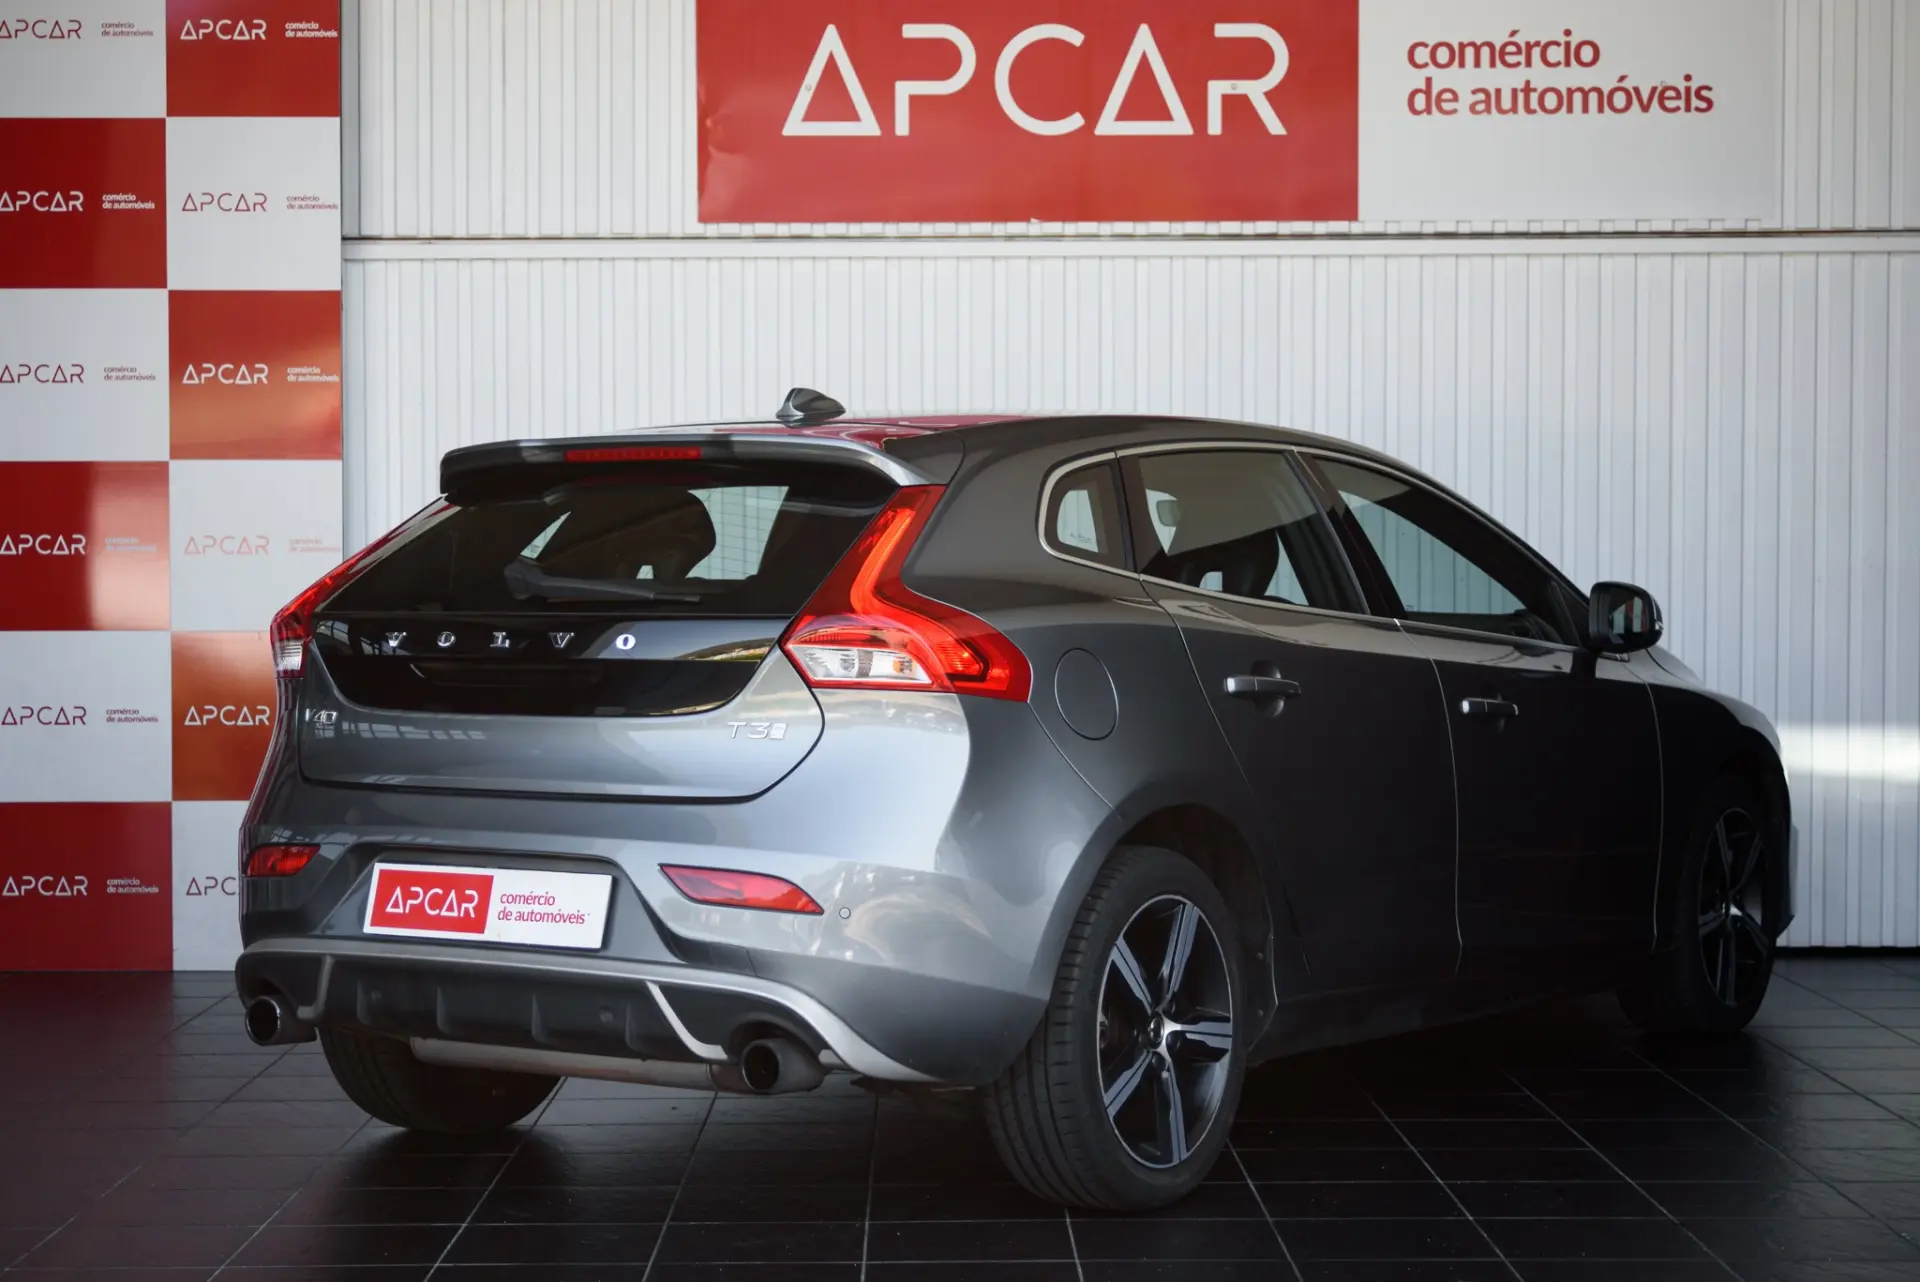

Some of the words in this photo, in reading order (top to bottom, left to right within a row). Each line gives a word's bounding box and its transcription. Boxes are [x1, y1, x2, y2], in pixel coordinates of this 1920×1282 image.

[0, 19, 82, 39] APCAR
[180, 19, 267, 40] APCAR
[285, 20, 319, 29] comércio
[285, 29, 295, 38] de
[296, 29, 338, 38] automóveis
[1407, 29, 1600, 69] comércio
[781, 23, 1290, 136] APCAR
[1407, 77, 1459, 116] de
[1469, 74, 1714, 116] automóveis
[0, 191, 84, 212] APCAR
[102, 193, 136, 201] comércio
[102, 201, 112, 209] de
[113, 200, 155, 209] automóveis
[182, 192, 267, 212] APCAR
[0, 363, 84, 384] APCAR
[182, 363, 269, 385] APCAR
[0, 534, 86, 555] APCAR
[184, 535, 270, 555] APCAR
[386, 631, 636, 650] VOLVO
[1, 706, 86, 726] APCAR
[184, 705, 270, 726] APCAR
[305, 708, 338, 725] V40
[727, 721, 770, 739] T3
[2, 875, 88, 896] APCAR
[186, 876, 238, 896] APC
[385, 885, 479, 918] APCAR
[499, 891, 556, 906] comércio
[497, 906, 514, 921] de
[514, 908, 585, 925] automóveis
